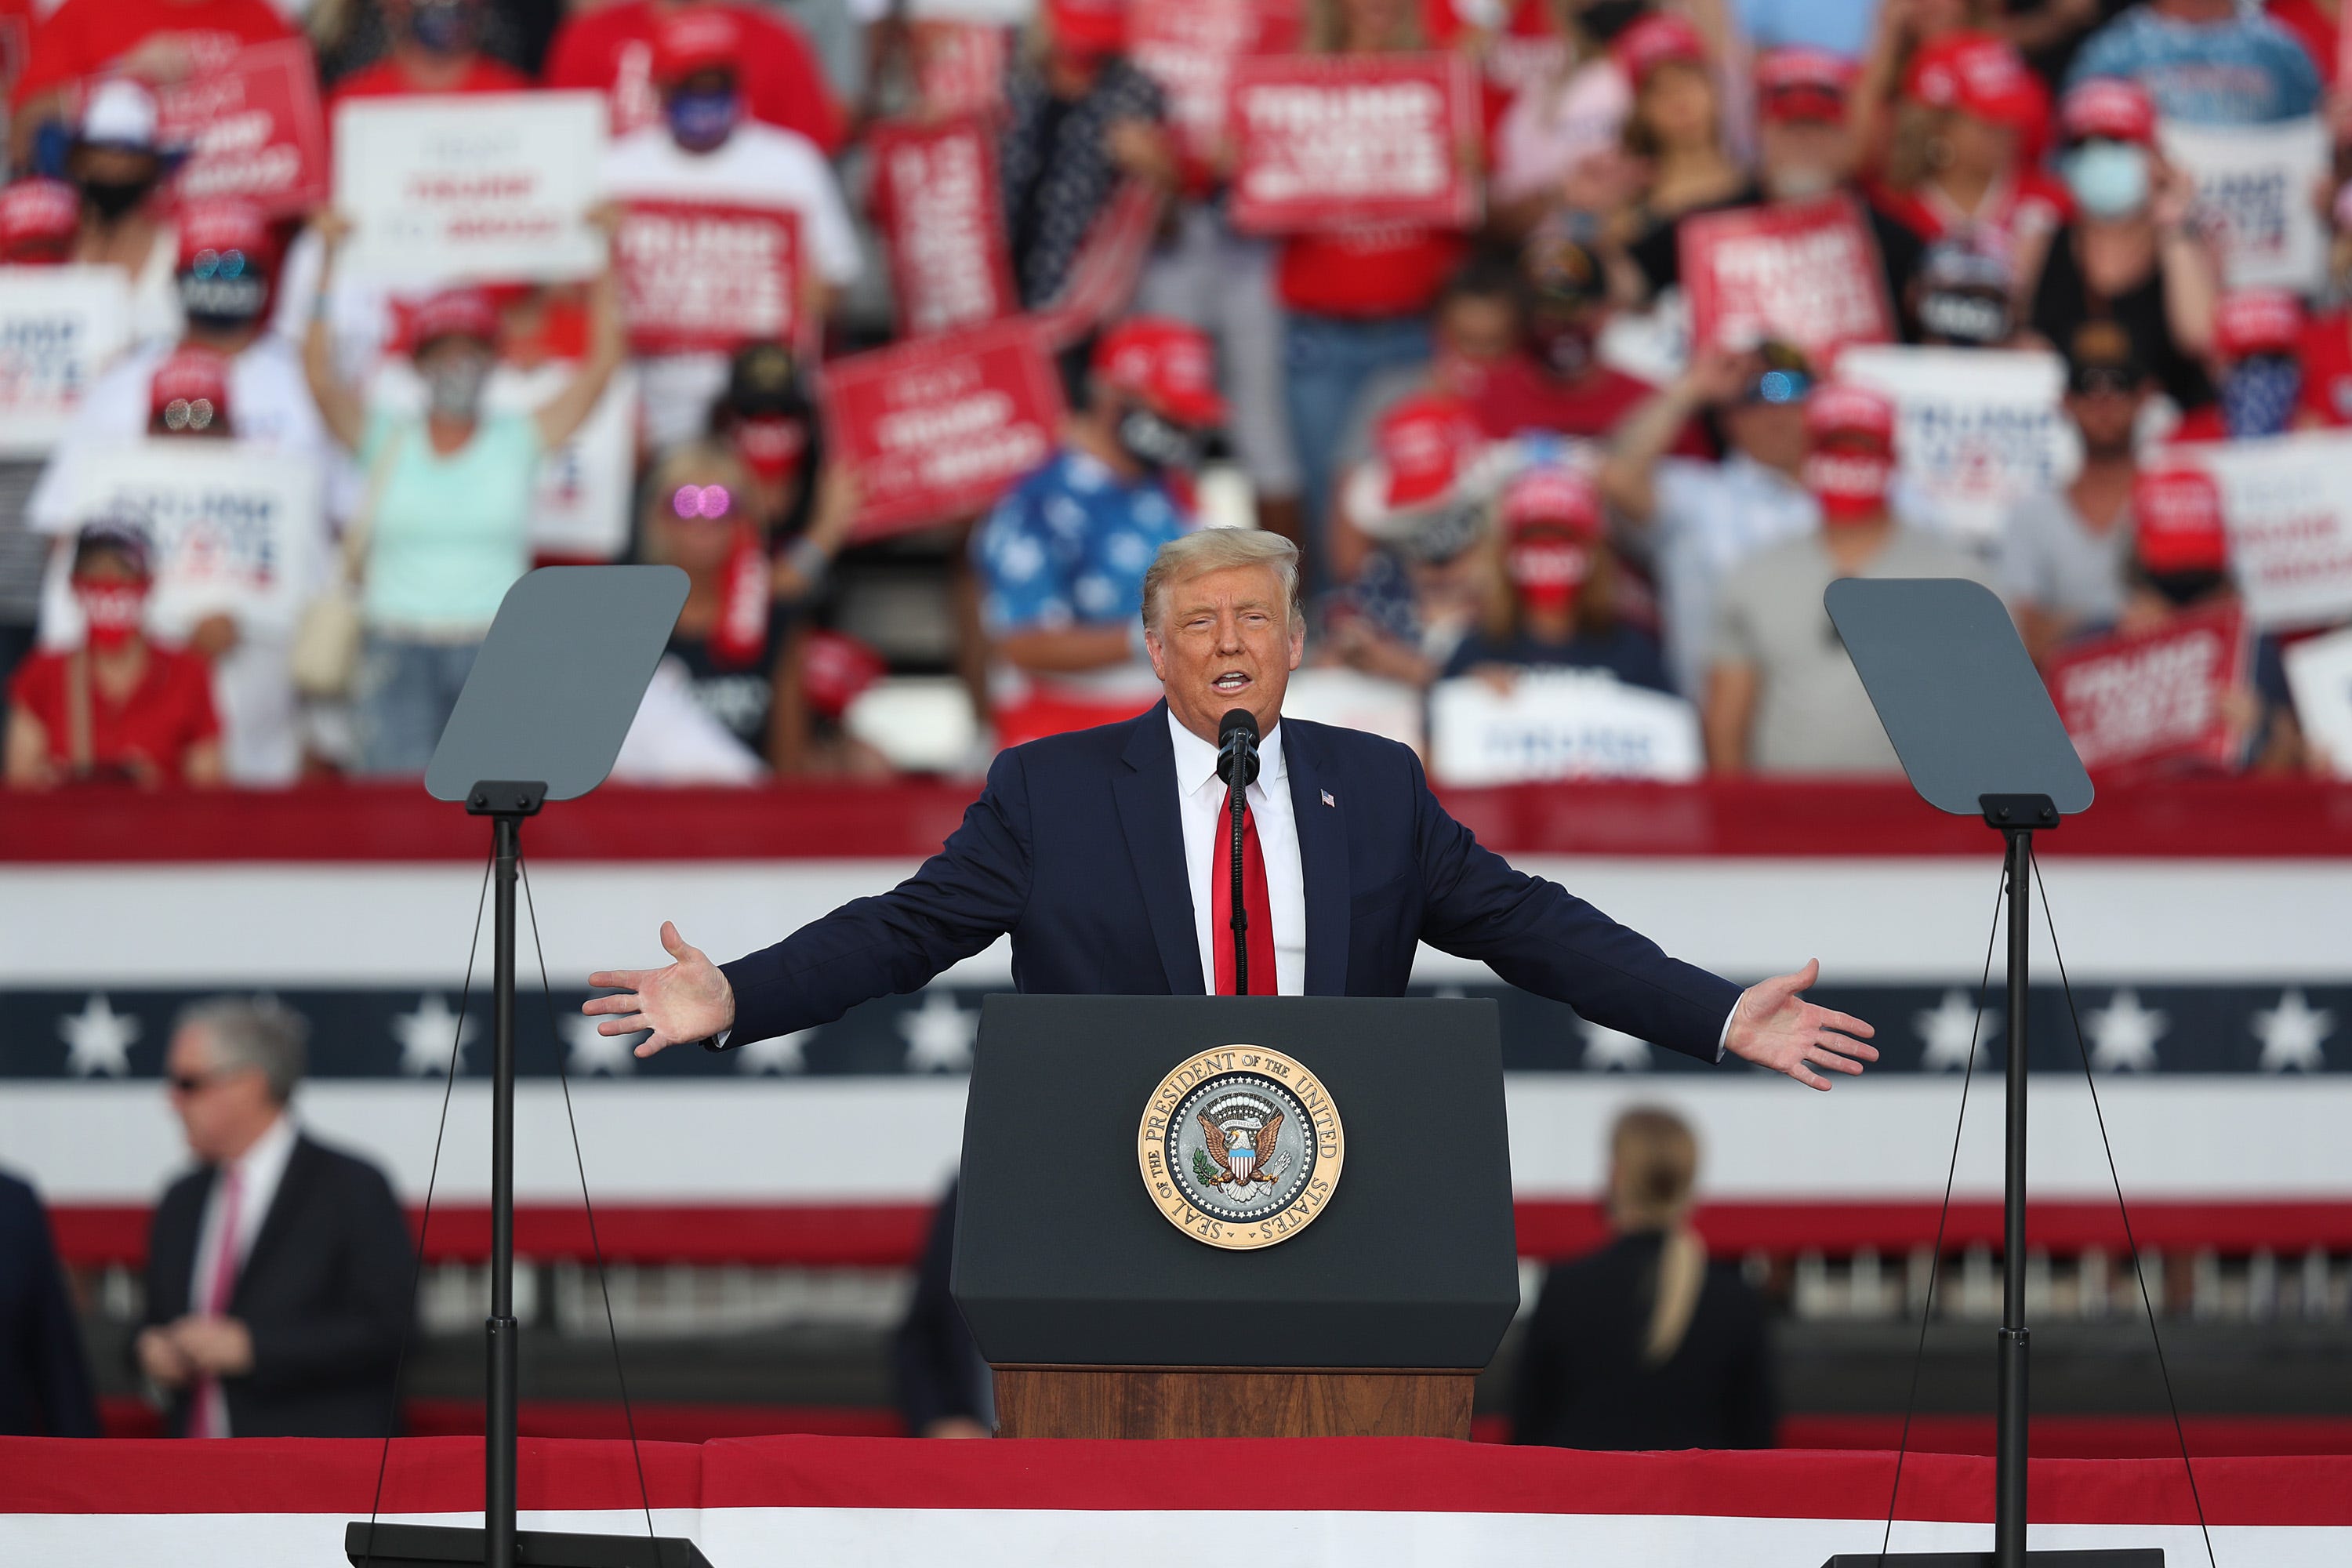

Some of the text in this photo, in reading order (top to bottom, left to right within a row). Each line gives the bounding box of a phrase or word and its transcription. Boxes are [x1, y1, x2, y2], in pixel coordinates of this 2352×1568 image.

[1145, 1051, 1338, 1240] SEAL OF THE PRESIDENT OF THE UNITED STATES
